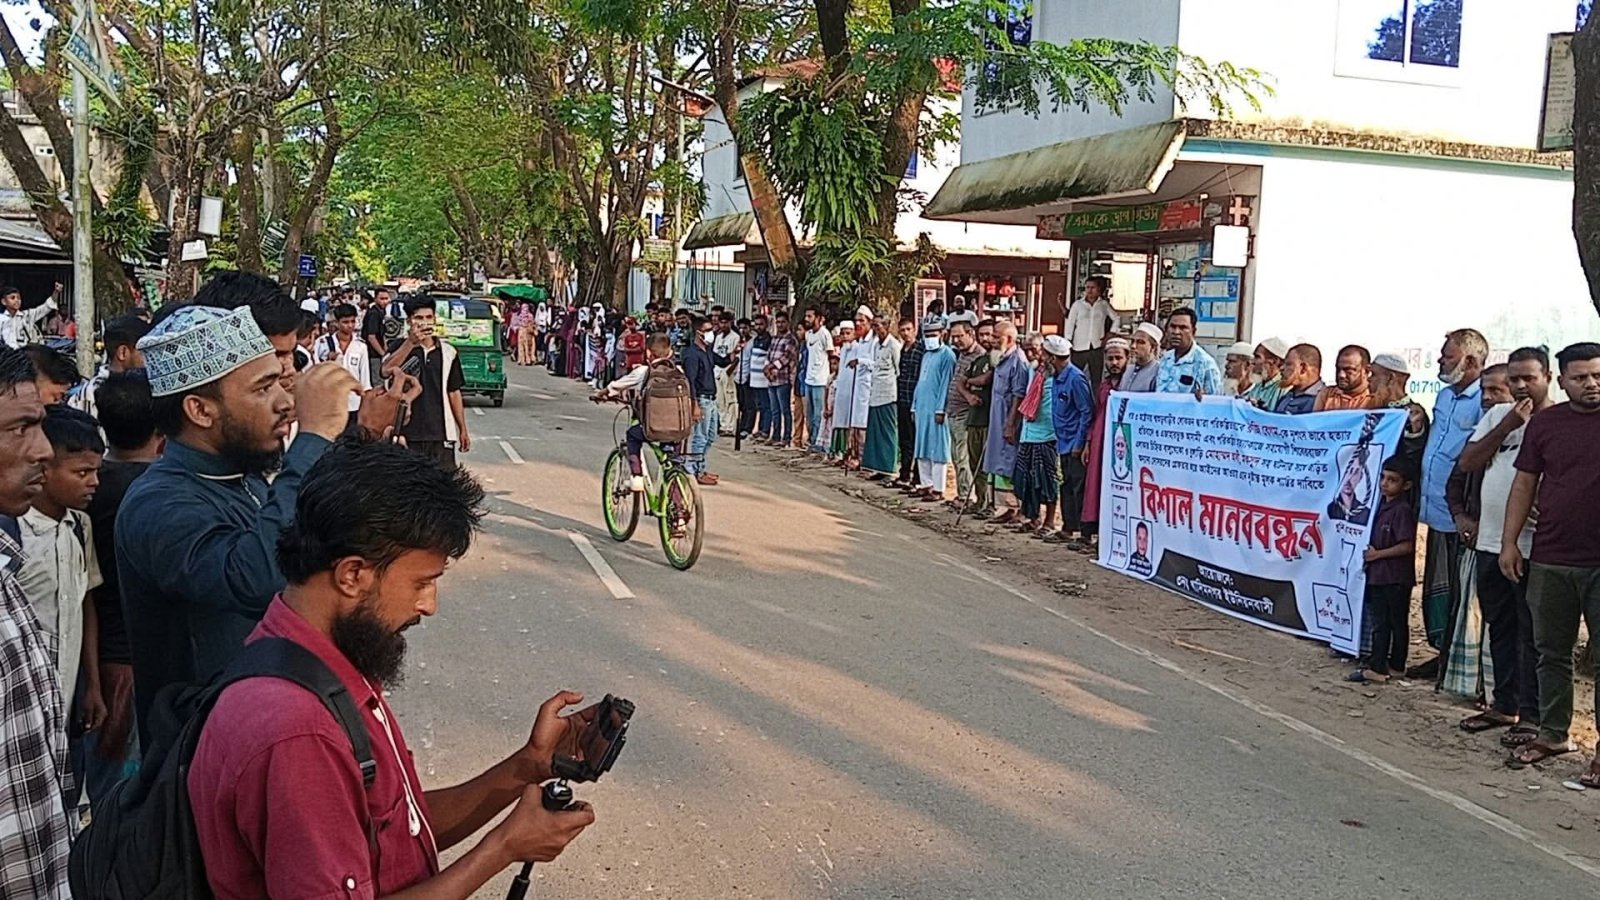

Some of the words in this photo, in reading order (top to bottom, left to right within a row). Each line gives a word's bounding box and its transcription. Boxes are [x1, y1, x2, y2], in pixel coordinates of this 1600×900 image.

[1410, 380, 1441, 393] 01710
[1139, 467, 1193, 532] বিশাল
[1199, 494, 1324, 561] মানববন্ধন
